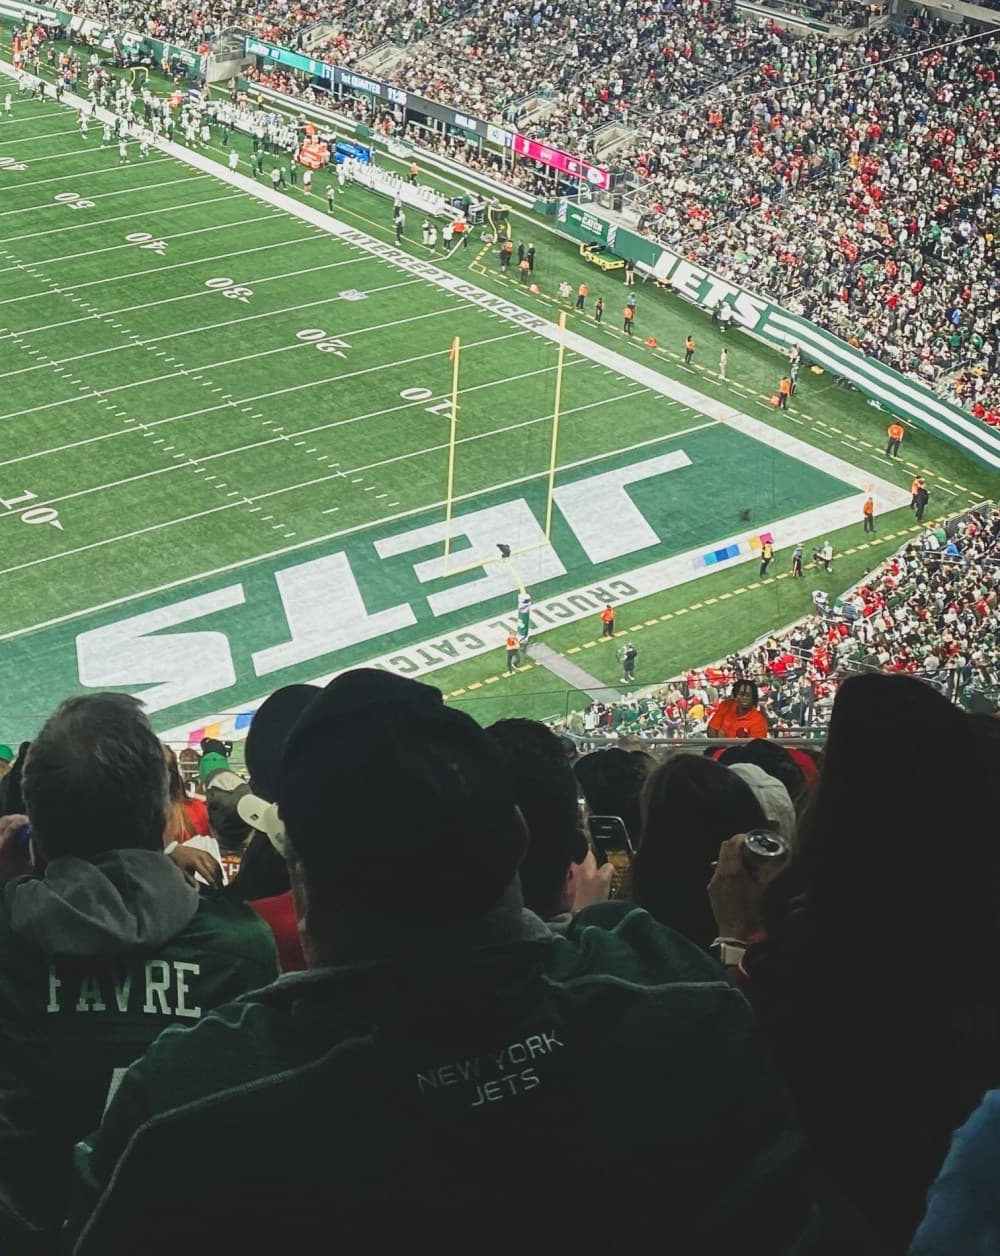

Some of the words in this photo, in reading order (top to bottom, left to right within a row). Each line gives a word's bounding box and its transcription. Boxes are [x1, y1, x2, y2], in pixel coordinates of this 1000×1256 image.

[351, 75, 381, 95] QUARTER
[53, 192, 96, 210] 50
[124, 232, 170, 250] 40
[204, 276, 254, 300] 30
[338, 229, 454, 282] INTERCEPT
[453, 283, 548, 330] CANCER
[635, 249, 769, 330] JETS
[295, 328, 353, 354] 20
[400, 387, 460, 416] 10
[75, 449, 694, 712] JETS
[47, 959, 202, 1019] FAVRE
[416, 1056, 481, 1094] NEW
[490, 1028, 565, 1072] YORK
[471, 1066, 541, 1107] JETS
